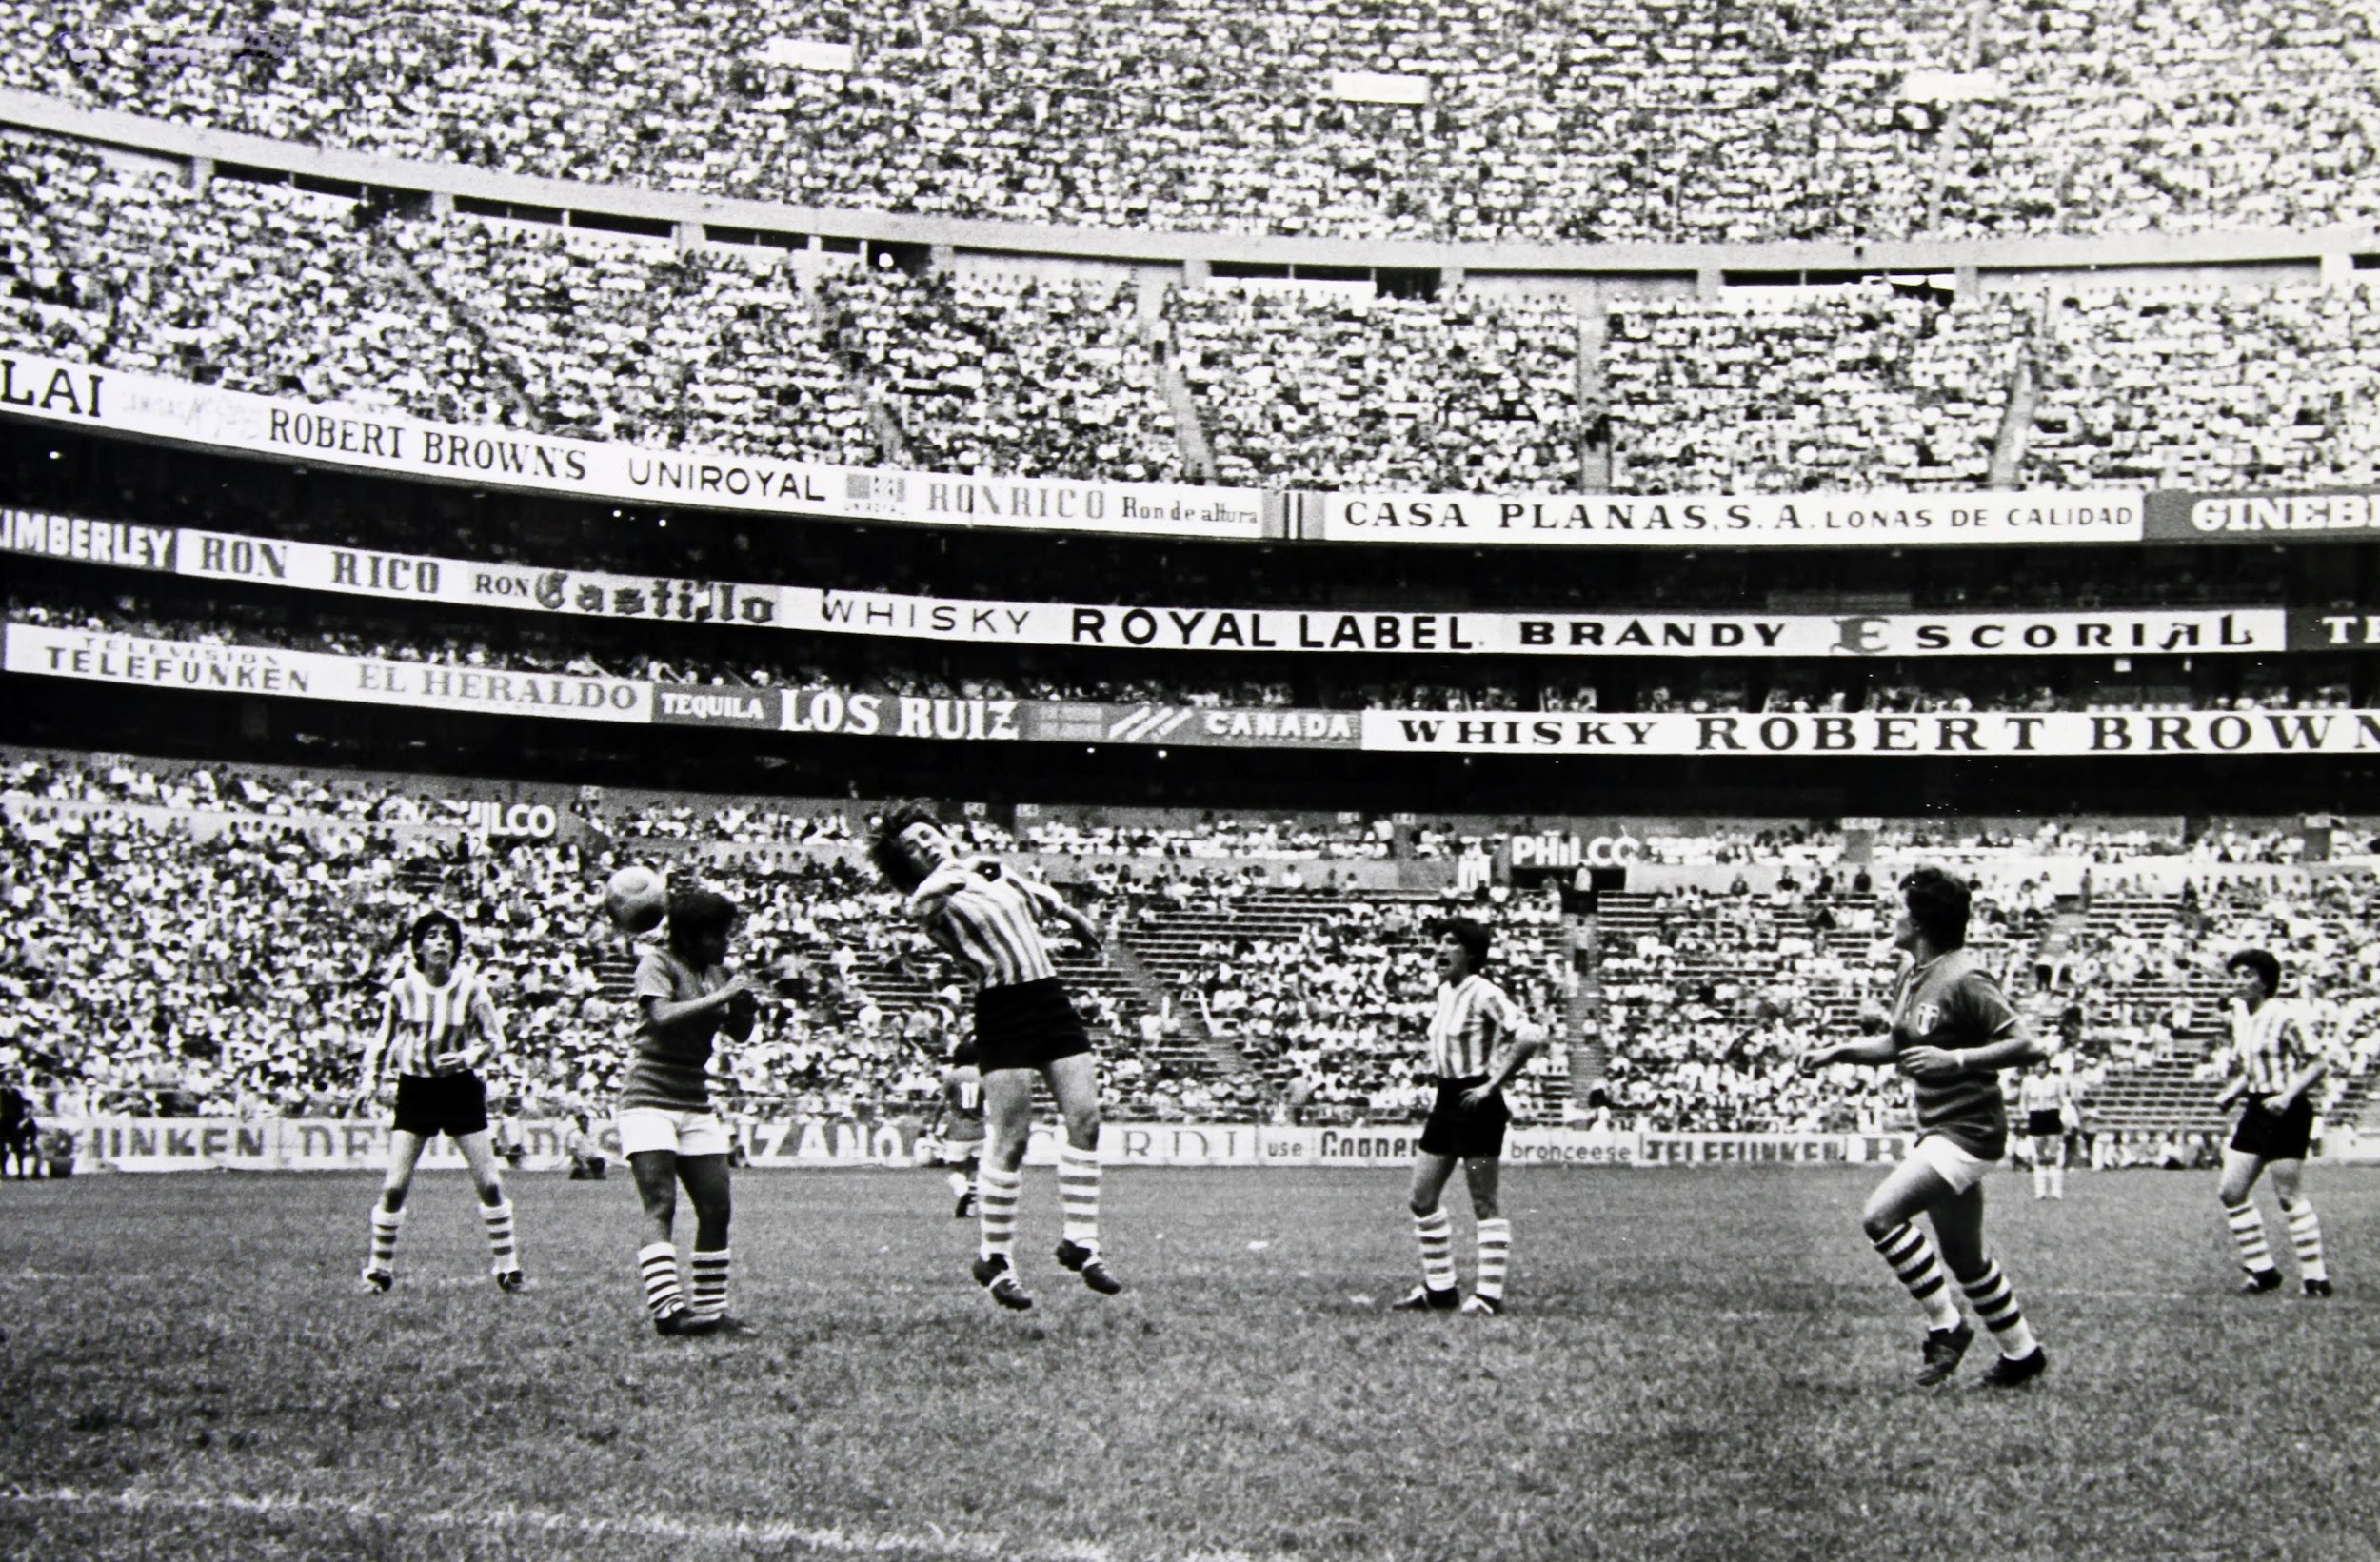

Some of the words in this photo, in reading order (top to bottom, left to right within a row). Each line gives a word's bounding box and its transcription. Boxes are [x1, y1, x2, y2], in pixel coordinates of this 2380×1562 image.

[0, 359, 104, 418] LAI
[269, 407, 406, 459] ROBERT
[423, 430, 586, 481] BROWN'S
[628, 458, 826, 502] UNIROYAL
[1122, 496, 1163, 520] Ron
[1201, 502, 1259, 524] altura
[1345, 501, 1469, 528] CASA
[1826, 510, 1933, 529] LONAS
[1952, 509, 1989, 527] DE
[2007, 507, 2133, 526] CALIDAD
[0, 508, 172, 568] IMBERLEY
[199, 535, 287, 579] RON
[331, 550, 440, 594] RICO
[475, 573, 529, 597] RON
[820, 592, 1030, 635] WHISKY
[1073, 608, 1276, 648] ROYAL
[1519, 620, 1785, 648] BRANDY
[1829, 613, 2254, 655] ESCORIAL
[46, 646, 309, 693] TELEFUNKEN
[84, 637, 279, 666] TELEVISION
[358, 664, 405, 692] EL
[422, 669, 637, 710] HERALDO
[662, 692, 764, 721] TEQUILA
[779, 688, 880, 736] LOS
[899, 696, 1020, 741] RUIZ
[1206, 711, 1352, 738] CANADA
[1400, 717, 1659, 746] WHISKY
[1695, 716, 2045, 752] ROBERT
[1512, 835, 1641, 868] PHILCO
[1268, 1141, 1303, 1157] use
